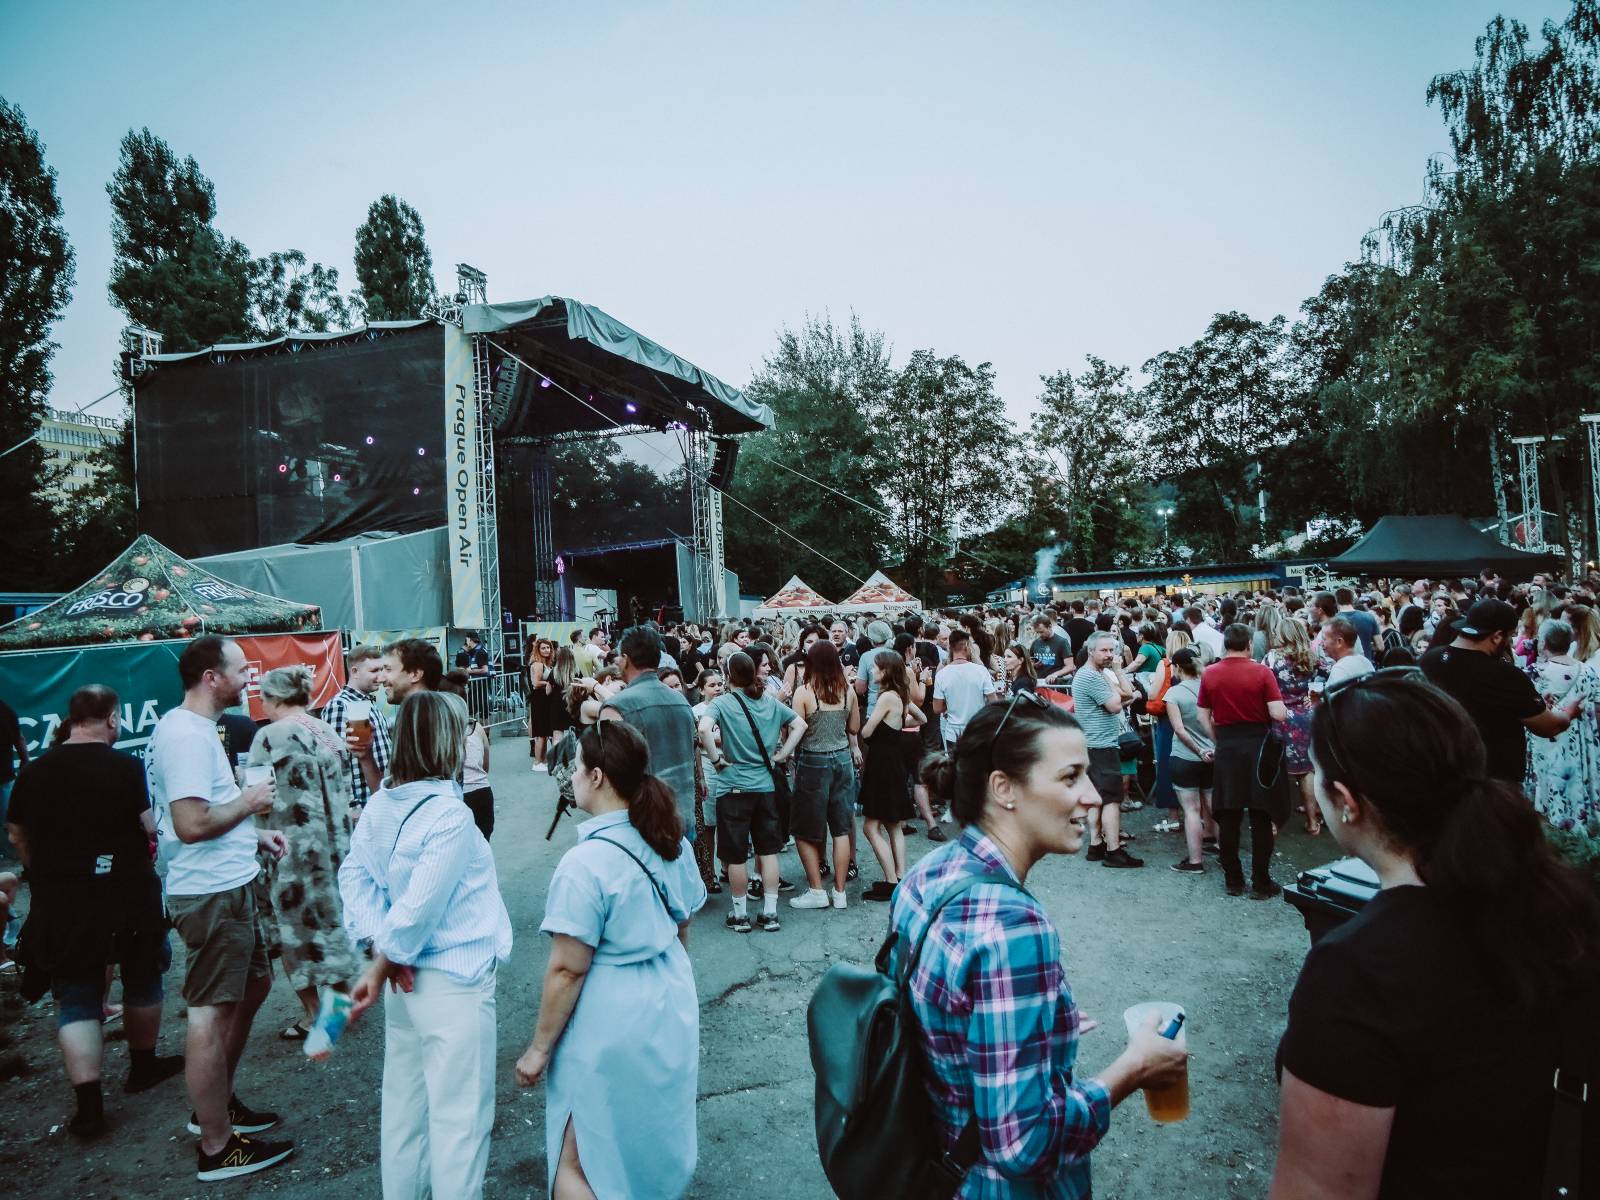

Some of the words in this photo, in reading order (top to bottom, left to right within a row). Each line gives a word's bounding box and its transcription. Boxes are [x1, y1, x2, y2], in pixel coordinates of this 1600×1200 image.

[454, 383, 466, 464] Prague
[456, 469, 469, 530] Open
[459, 535, 472, 567] Air
[66, 591, 144, 615] FRISCO
